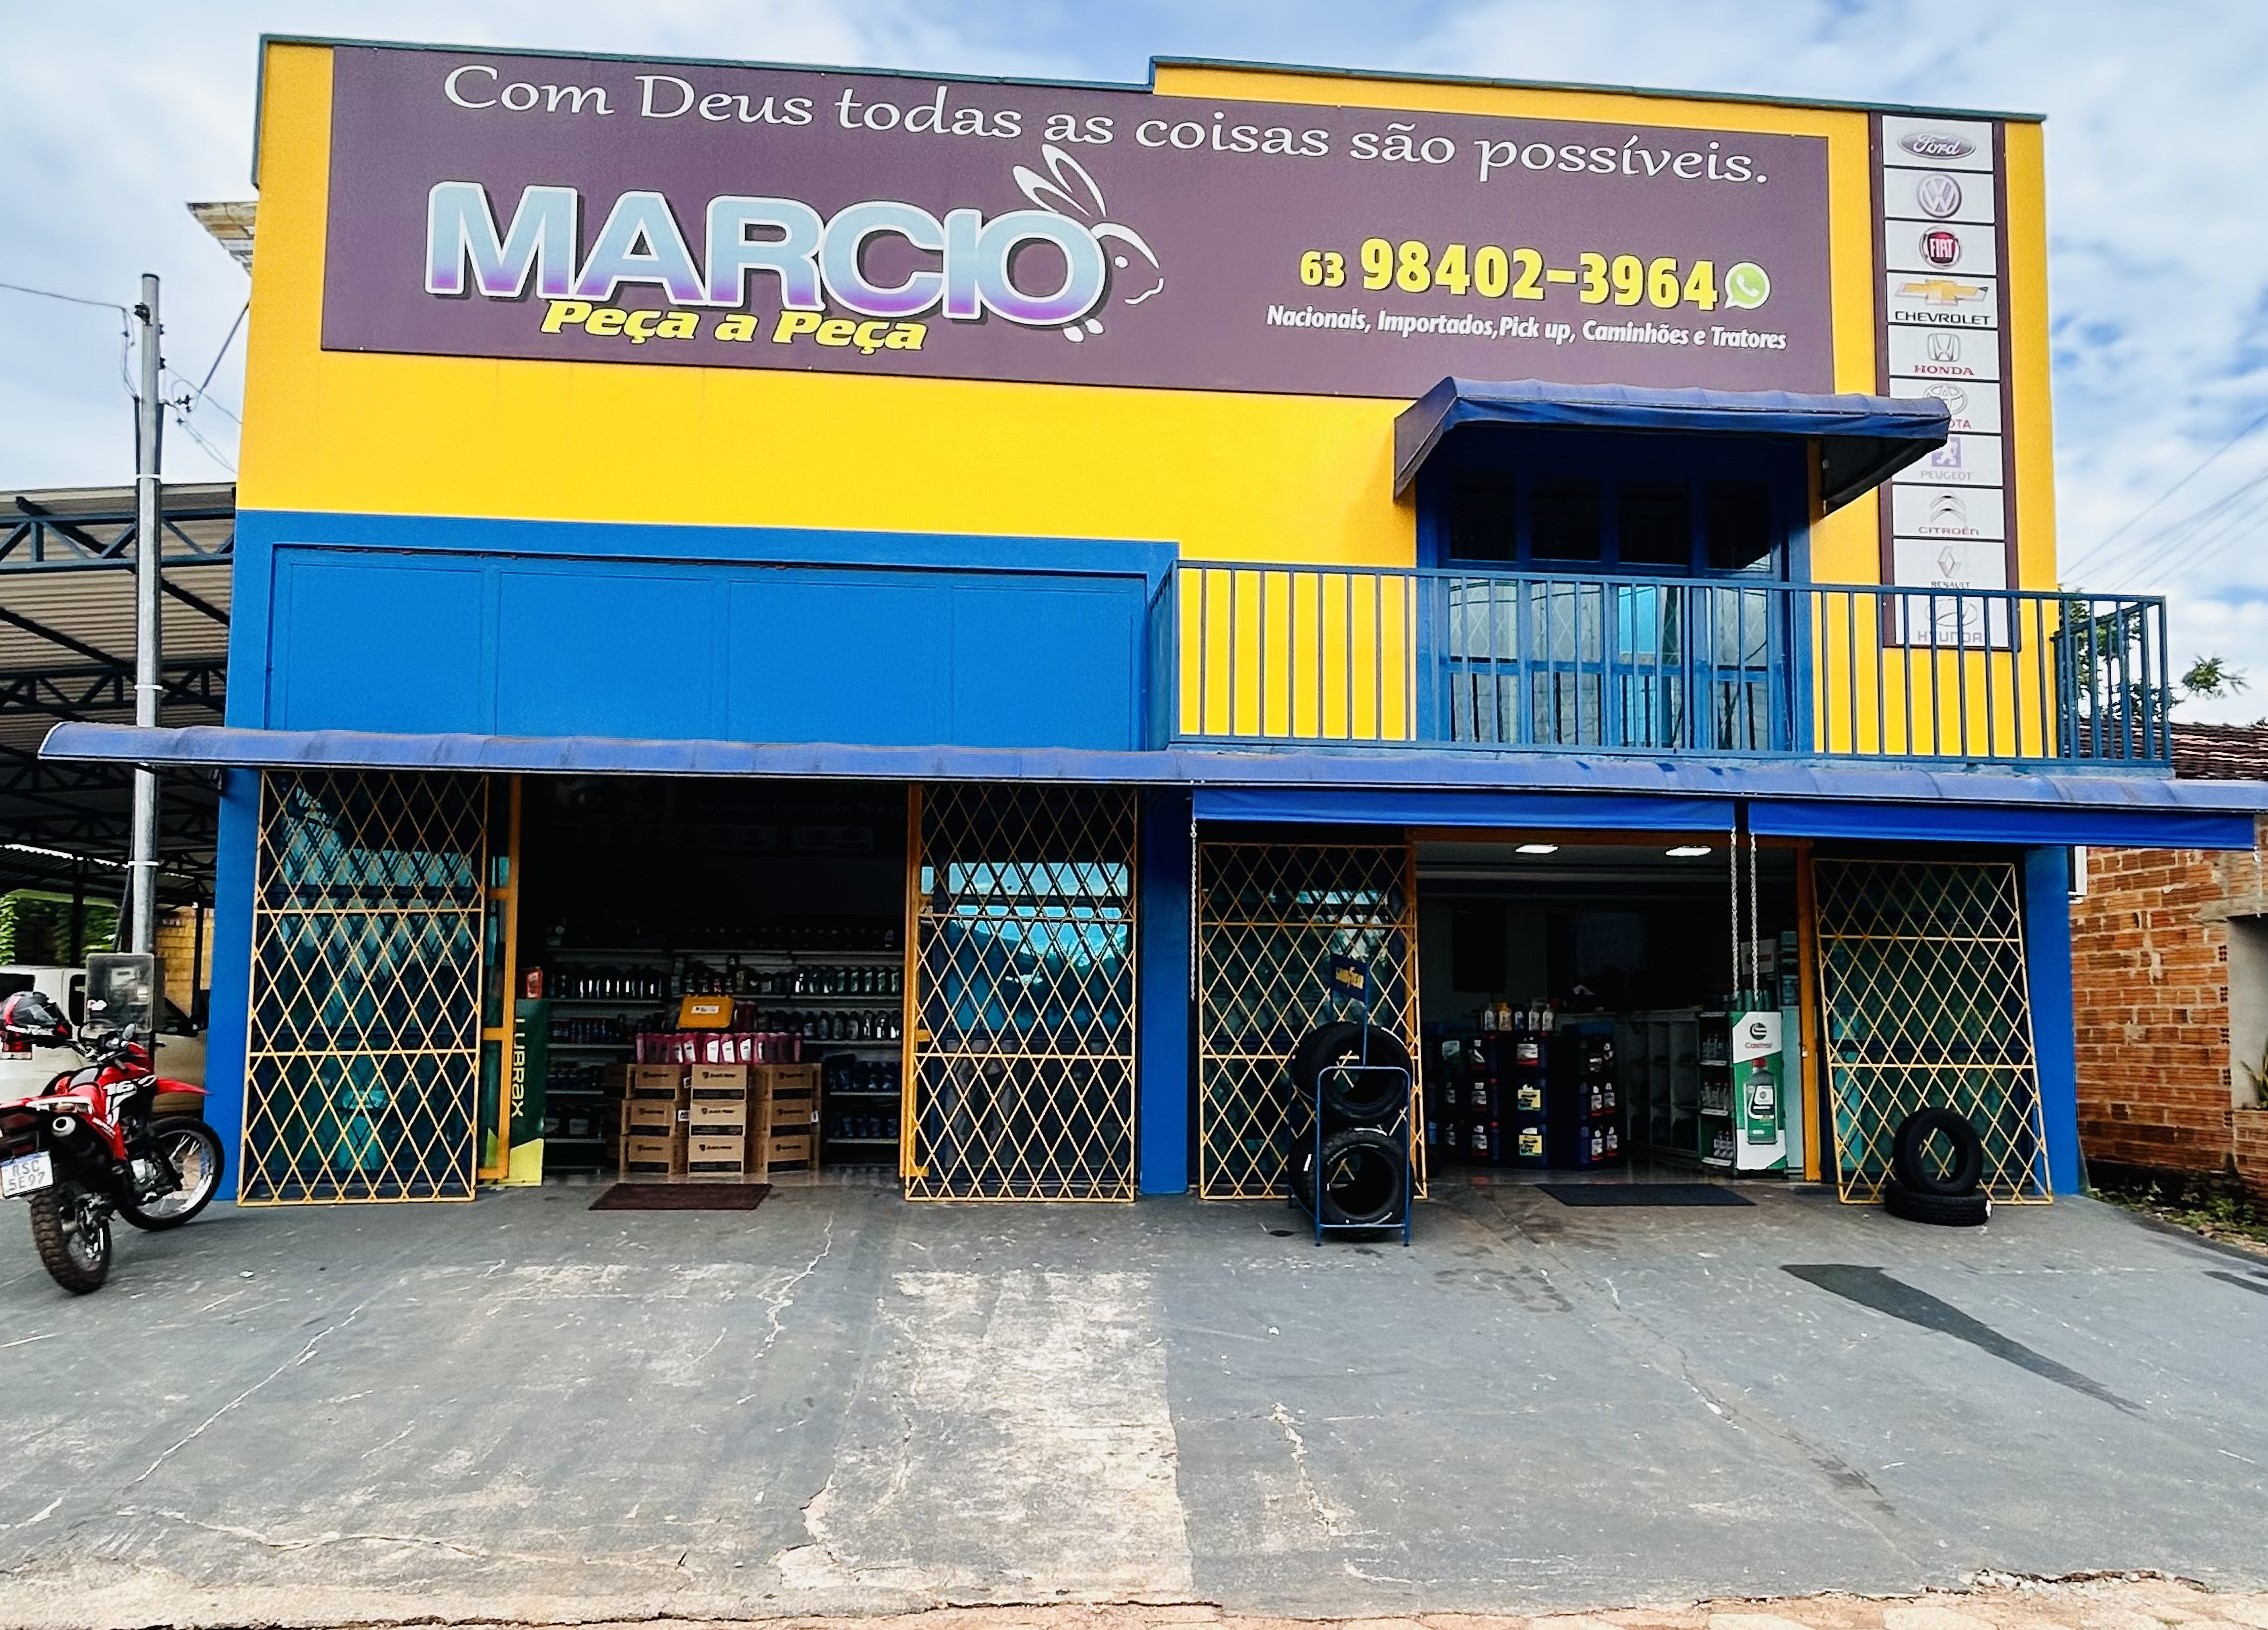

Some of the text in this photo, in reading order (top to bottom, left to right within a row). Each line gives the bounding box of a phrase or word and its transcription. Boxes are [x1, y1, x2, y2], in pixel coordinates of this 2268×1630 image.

[444, 65, 1768, 183] Com Deus todas as coisas são possíveis.
[1912, 133, 1962, 157] Ford
[424, 180, 1107, 325] MARCIO
[1929, 238, 1954, 258] FIAT
[1299, 238, 1719, 311] 63 98402-3964
[540, 300, 927, 352] Peça a Peça
[1266, 306, 1372, 334] Nacionais,
[1544, 322, 1576, 346] up,
[1582, 319, 1690, 348] Caminhões
[1694, 332, 1706, 346] e
[1711, 326, 1787, 351] Tratores
[1895, 311, 1991, 325] CHEVROLET
[1914, 365, 1975, 376] HONDA
[1920, 470, 1972, 481] PEUGEOT
